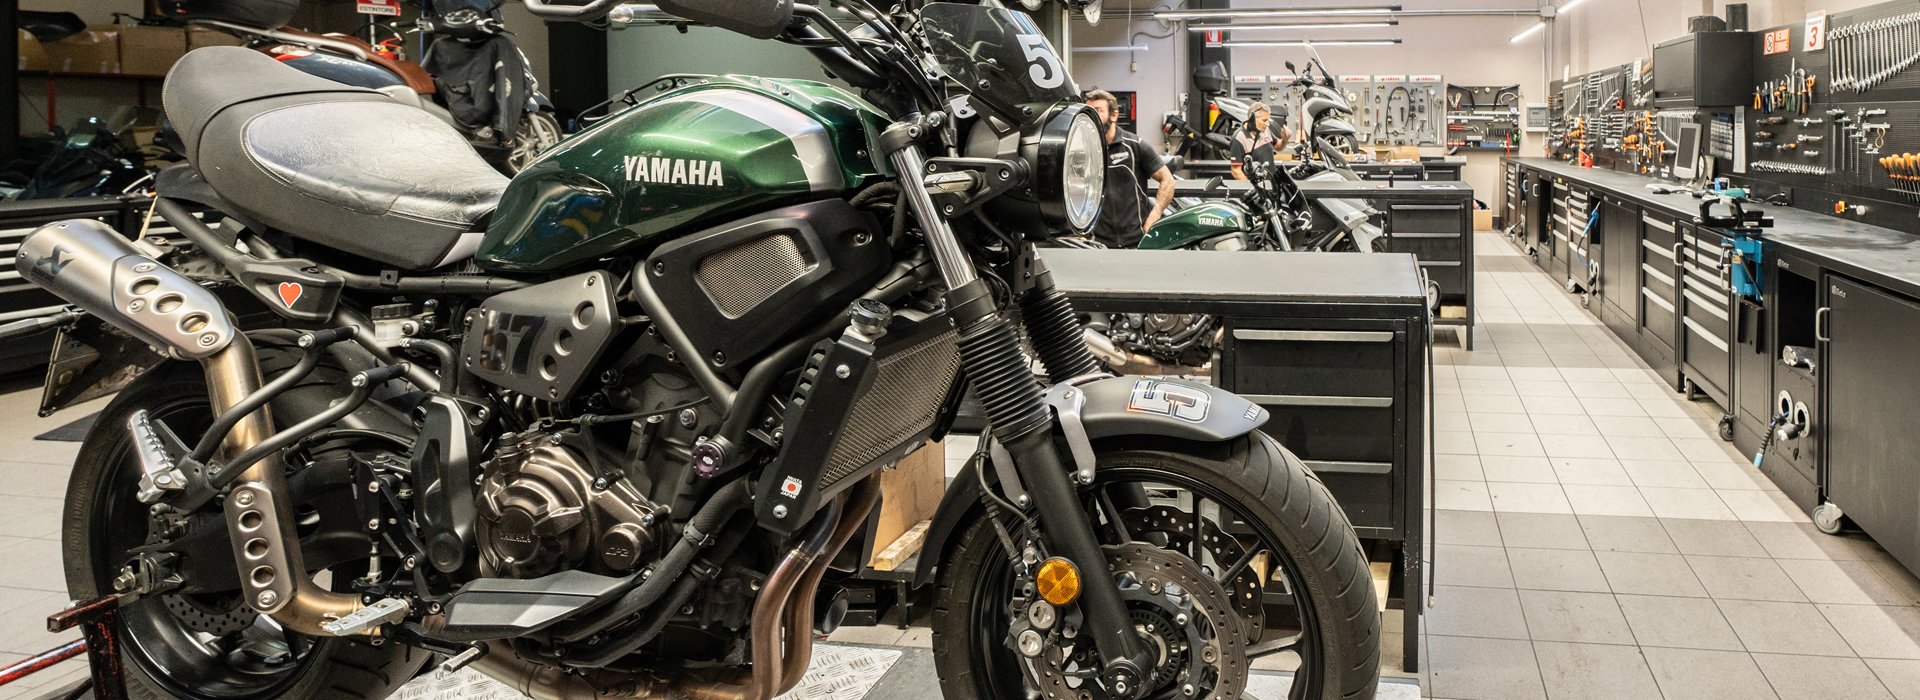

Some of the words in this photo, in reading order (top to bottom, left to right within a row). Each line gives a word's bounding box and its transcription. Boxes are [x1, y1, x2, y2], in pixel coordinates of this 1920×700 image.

[359, 4, 396, 14] ESTINTORE
[1809, 26, 1818, 47] 3
[1015, 33, 1065, 89] 5
[623, 155, 724, 187] YAMAHA
[1198, 217, 1224, 227] YAMAHA
[787, 475, 802, 484] IWATA
[780, 490, 797, 499] JAPAN
